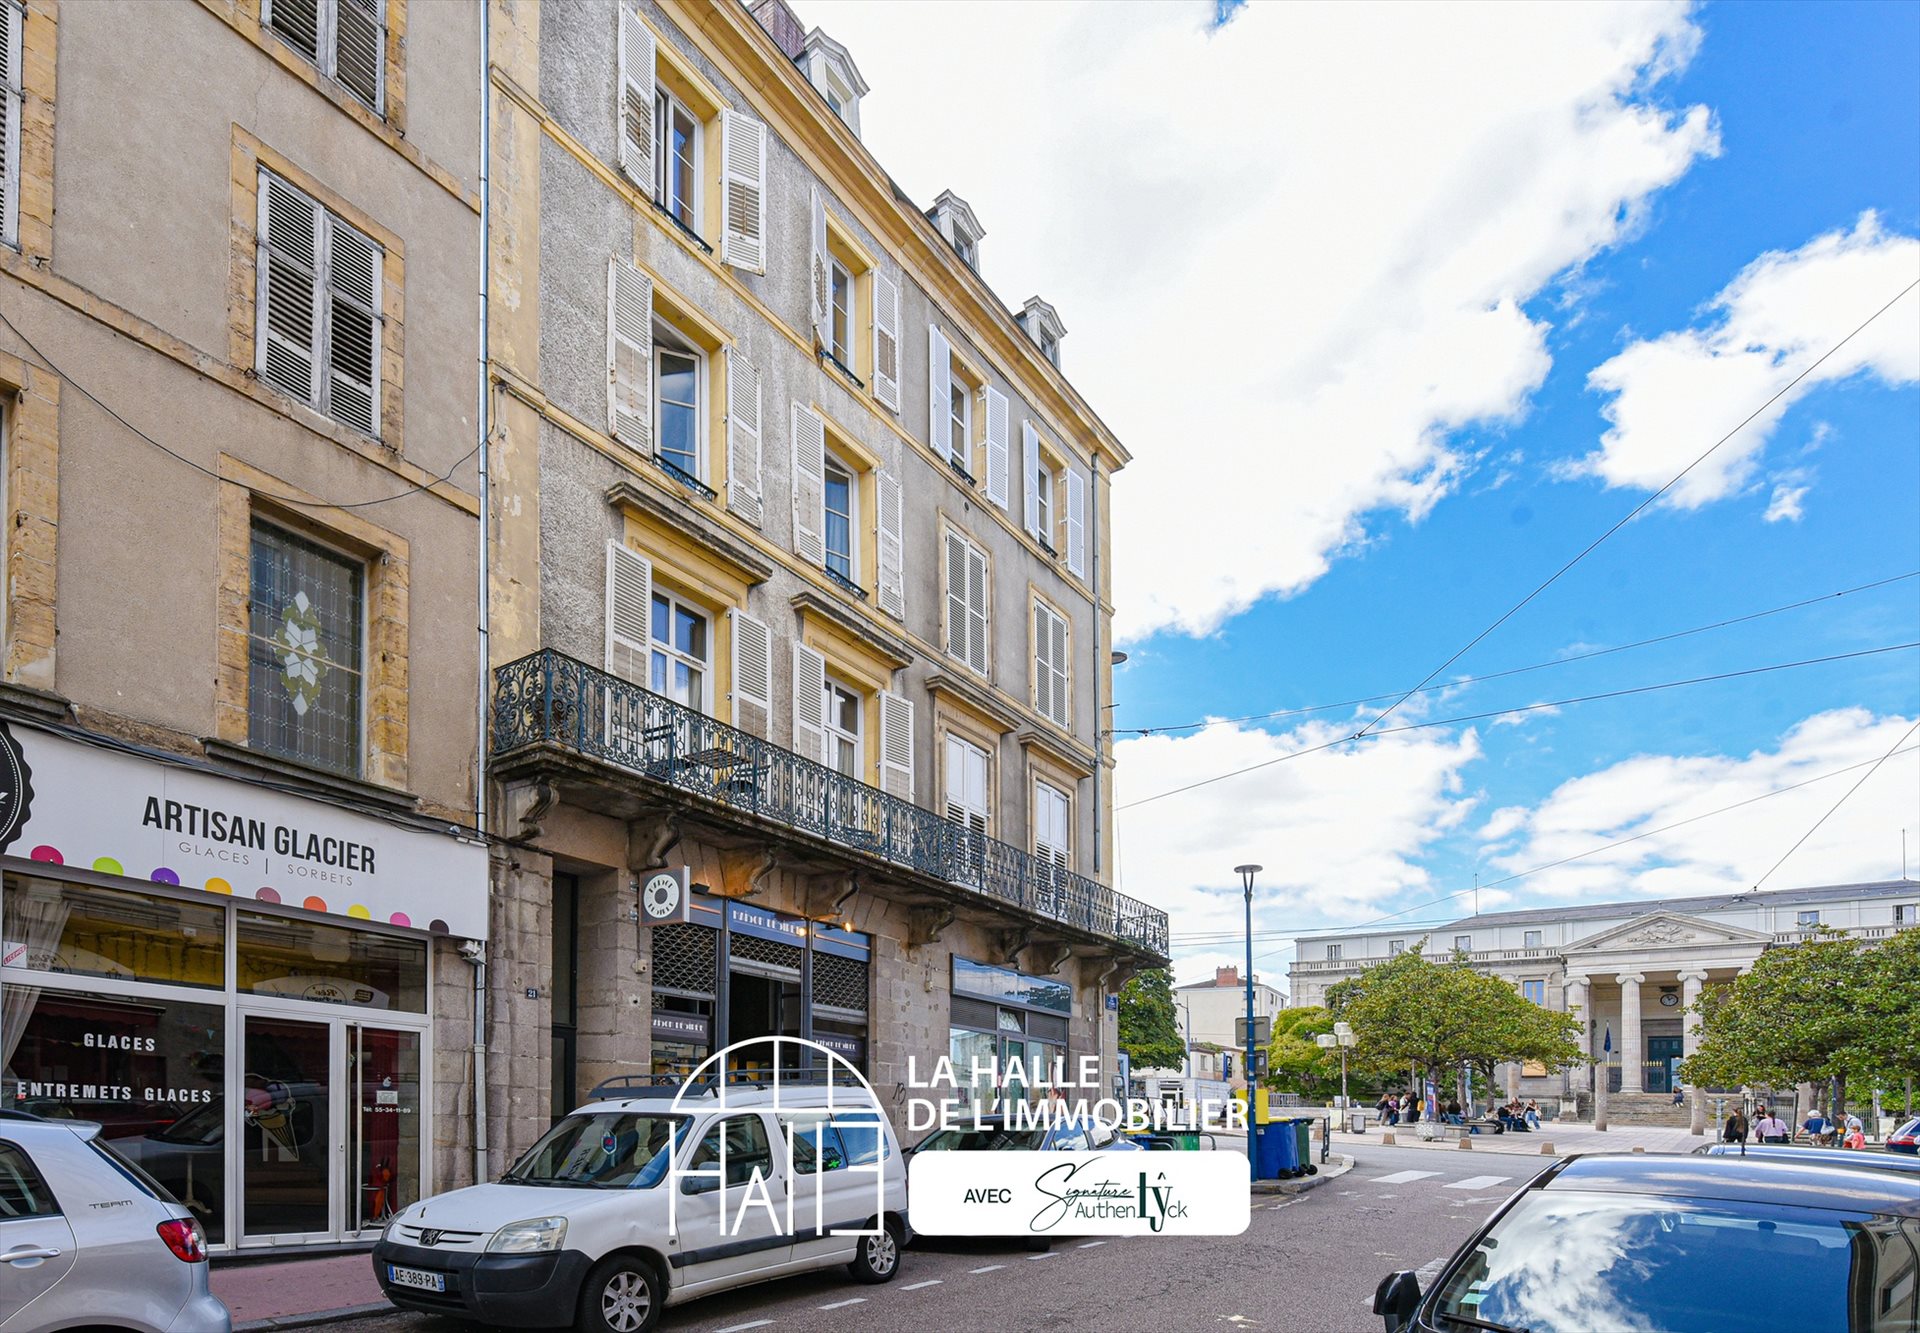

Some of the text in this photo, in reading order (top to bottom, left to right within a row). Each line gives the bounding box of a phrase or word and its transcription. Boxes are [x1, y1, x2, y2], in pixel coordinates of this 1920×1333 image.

[142, 796, 376, 874] ARTISAN GLACIER
[178, 841, 353, 886] GLACES SORBETS
[83, 1033, 156, 1052] GLACES
[17, 1081, 212, 1103] ENTREMETS GLACES
[88, 1199, 133, 1209] TEAM
